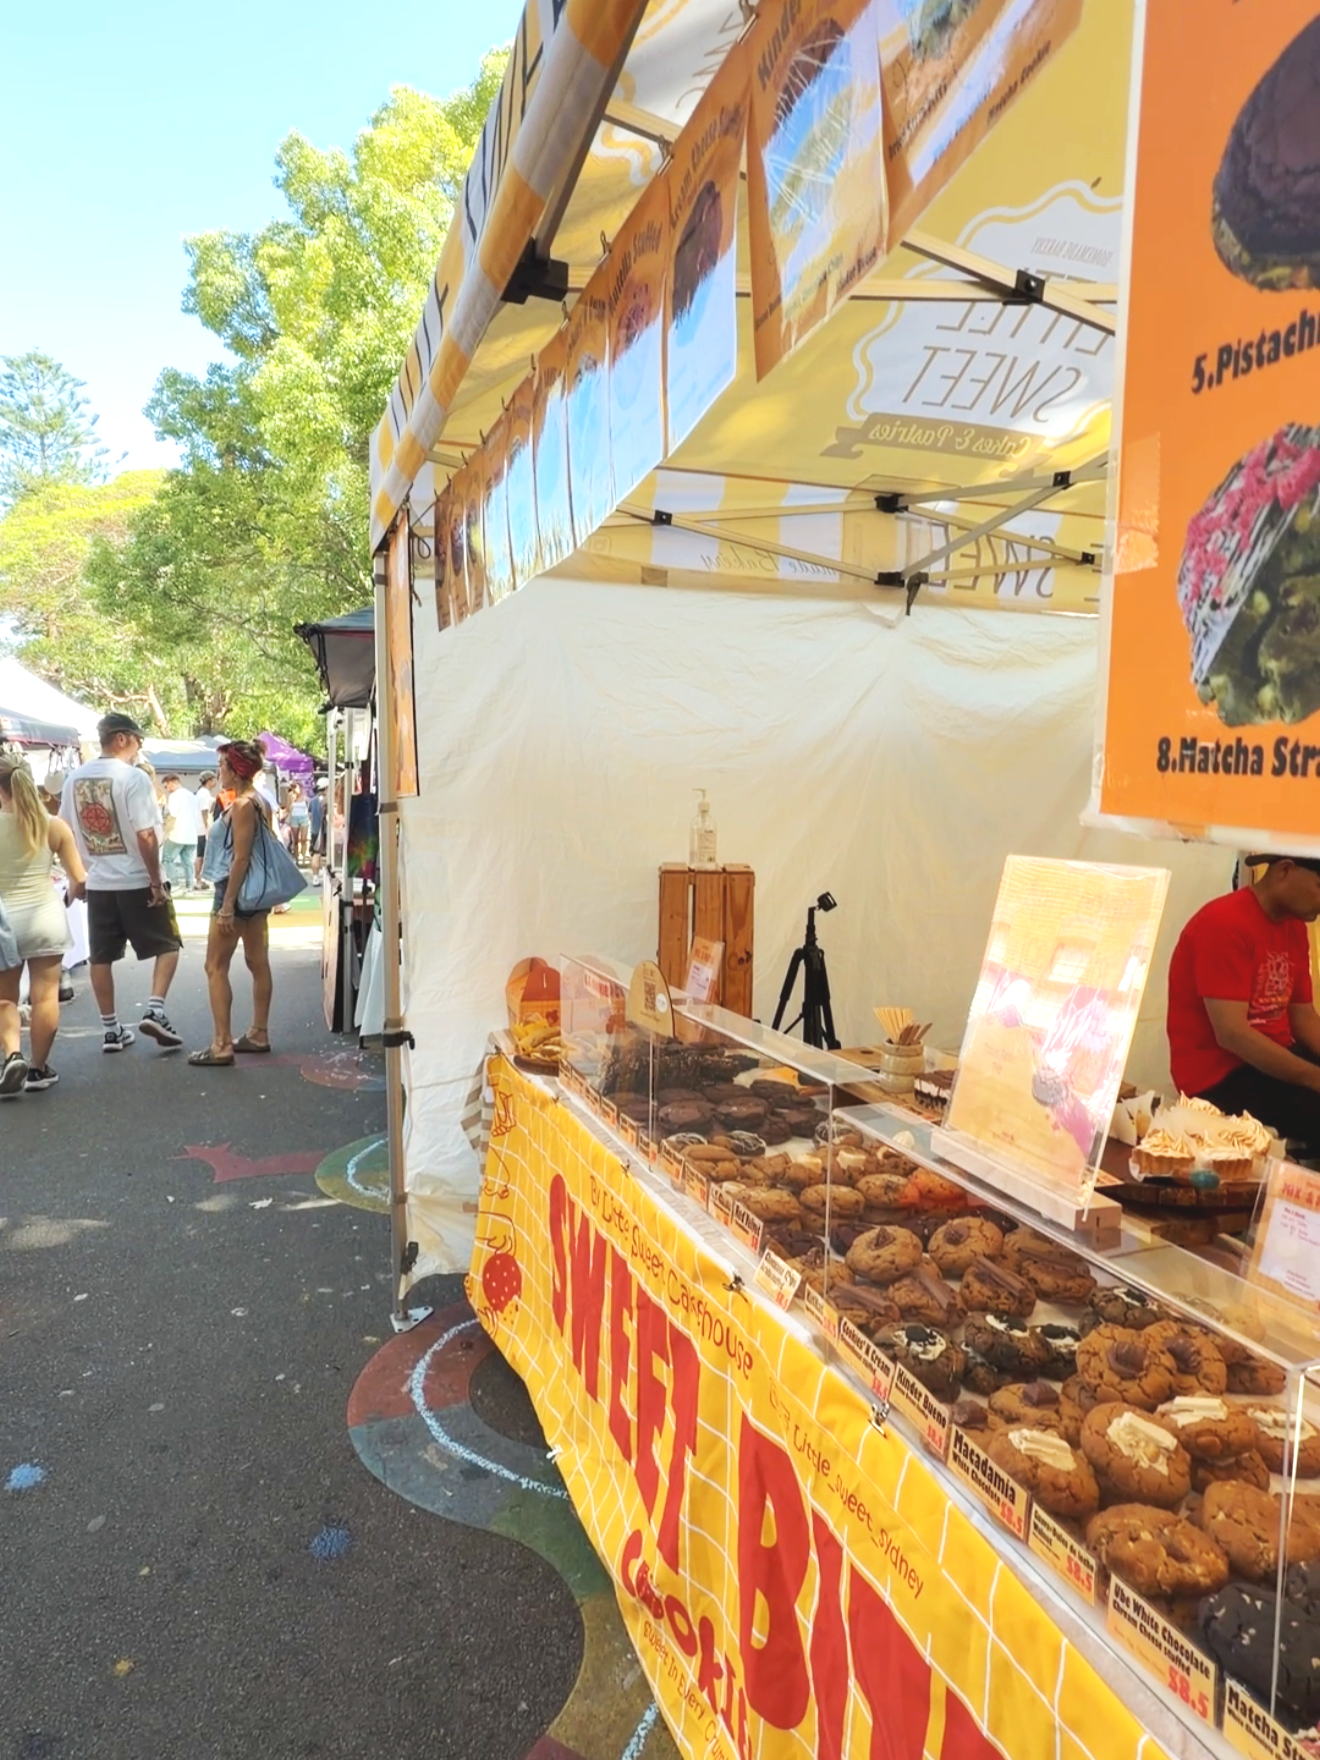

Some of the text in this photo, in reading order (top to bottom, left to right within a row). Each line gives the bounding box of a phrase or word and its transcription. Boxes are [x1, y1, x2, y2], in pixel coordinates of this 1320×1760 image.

[1156, 735, 1265, 776] 8.Matcha
[549, 1173, 700, 1577] SWEET
[871, 1349, 891, 1378] Cream
[897, 1366, 923, 1402] Kinder
[923, 1394, 947, 1429] Bueno
[951, 1449, 971, 1476] White
[970, 1468, 1002, 1507] Chocolate
[954, 1428, 1017, 1506] Macadamia
[1000, 1501, 1023, 1535] $8.5
[1066, 1554, 1093, 1593] $8.5
[1113, 1583, 1132, 1607] Ube
[1132, 1598, 1160, 1634] White
[1161, 1626, 1211, 1681] Chocolate
[667, 1657, 679, 1682] In
[676, 1673, 705, 1721] Every
[1168, 1663, 1209, 1720] $8.5
[1228, 1685, 1279, 1748] Matcha
